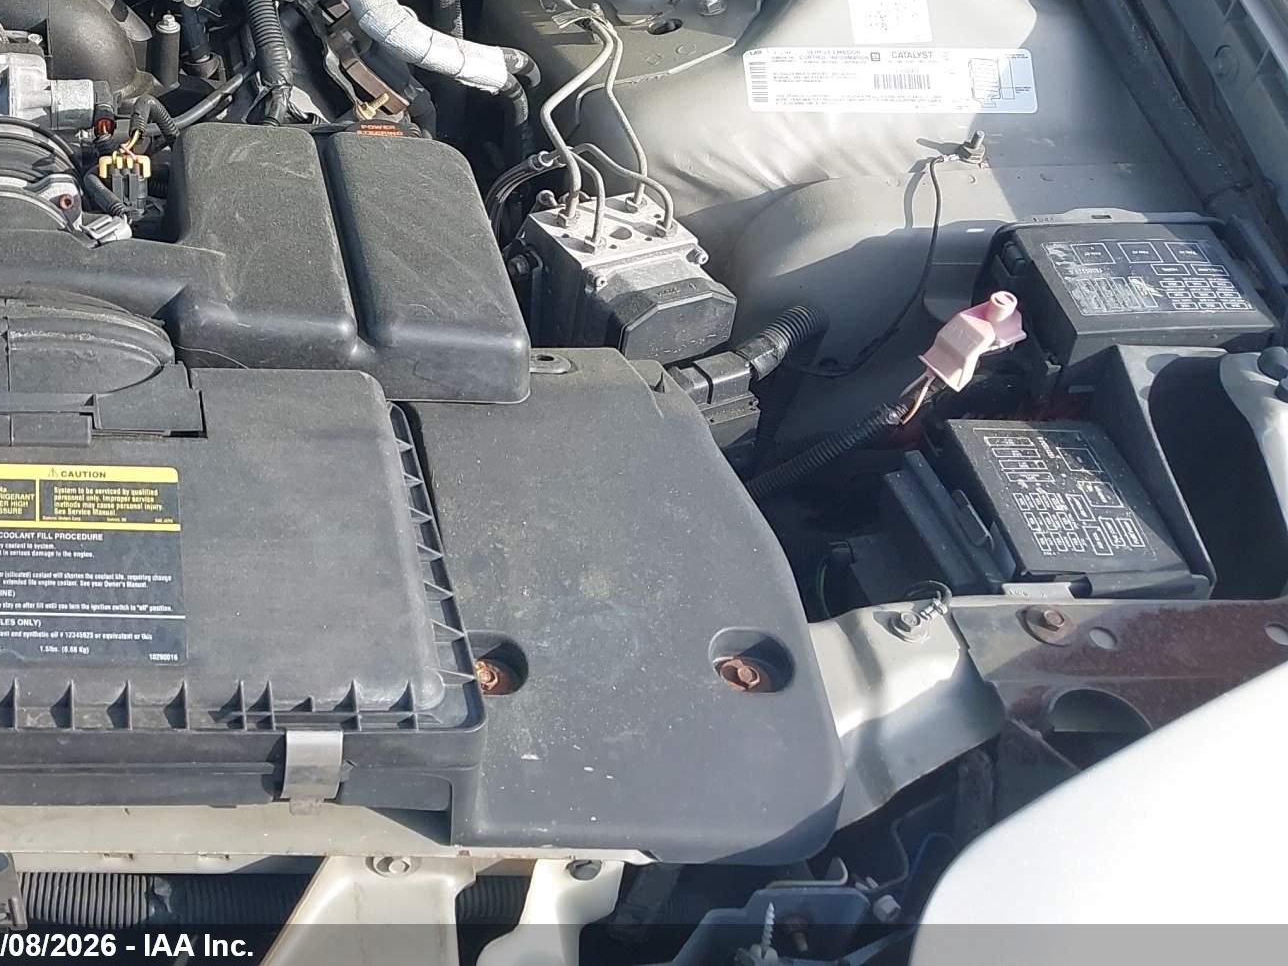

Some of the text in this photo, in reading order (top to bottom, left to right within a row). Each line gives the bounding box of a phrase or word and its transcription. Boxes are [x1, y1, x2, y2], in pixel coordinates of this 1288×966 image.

[891, 50, 933, 58] CATALYST
[60, 470, 106, 478] CAUTION
[54, 486, 76, 495] System
[130, 488, 158, 496] qualified
[102, 496, 130, 504] Improper
[16, 618, 42, 627] ONLY)
